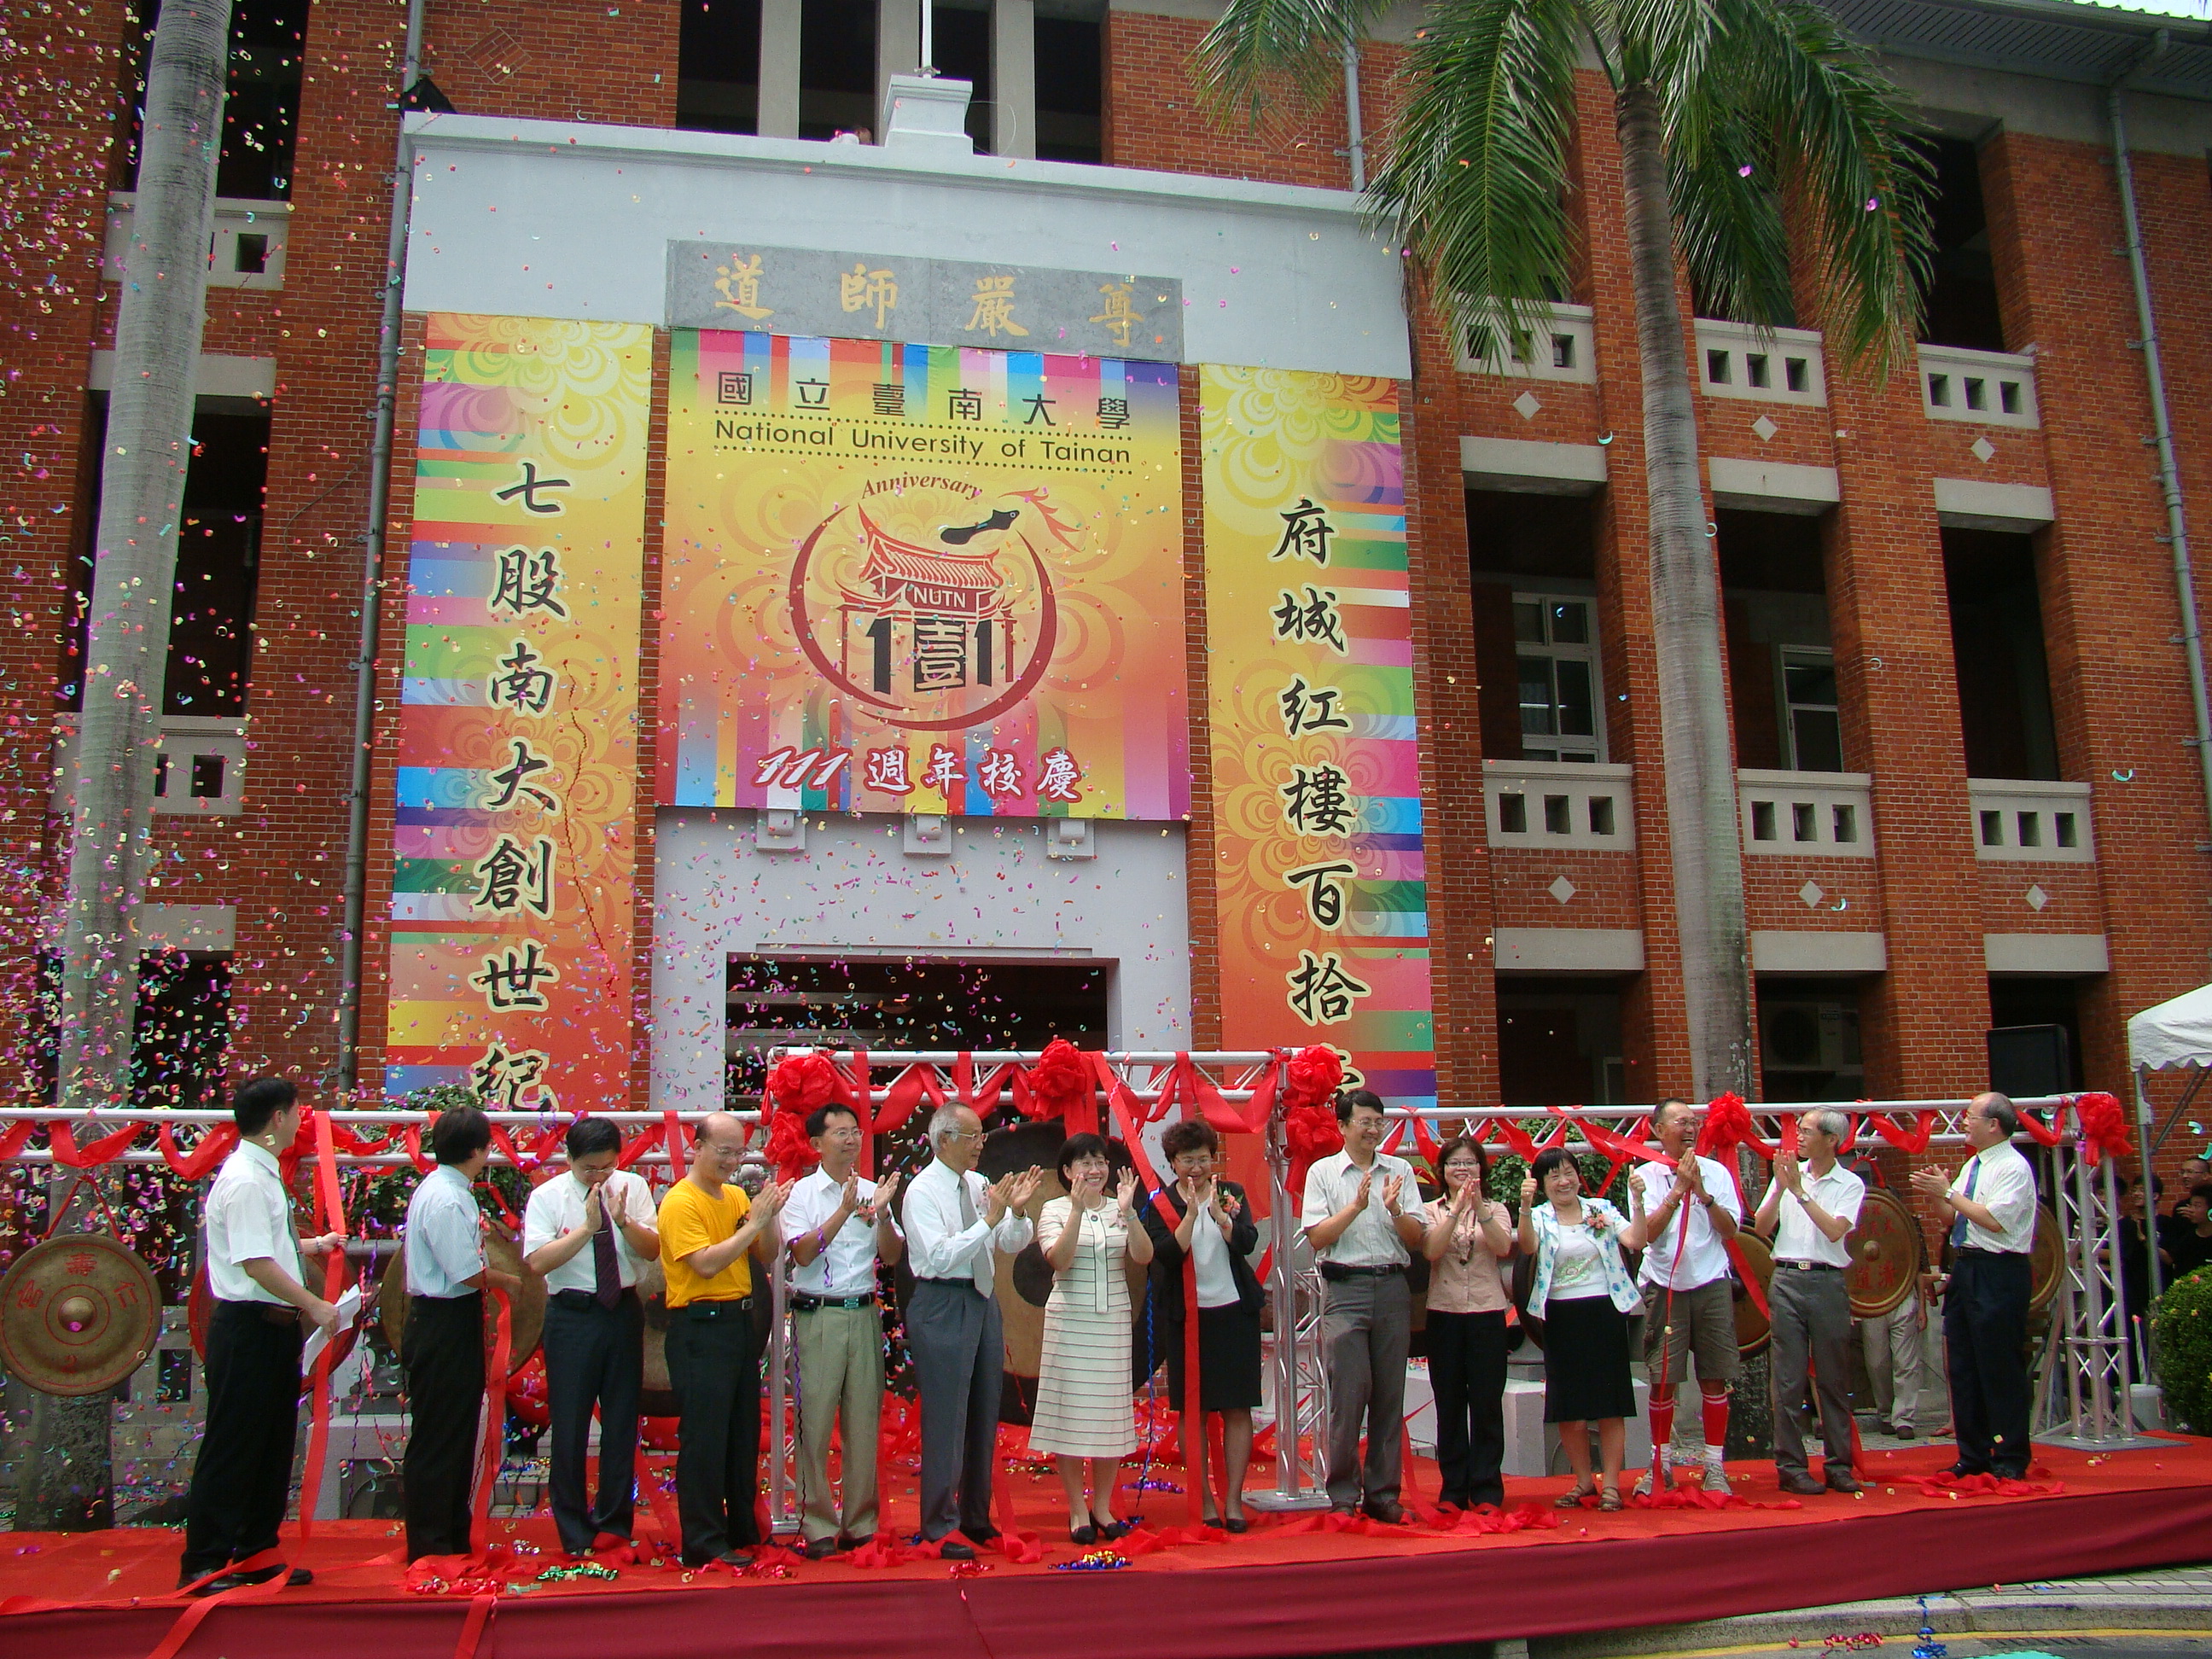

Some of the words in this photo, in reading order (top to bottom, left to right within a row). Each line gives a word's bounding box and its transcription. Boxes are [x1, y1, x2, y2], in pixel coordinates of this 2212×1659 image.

[718, 370, 1131, 430] 國立臺南大學
[715, 418, 834, 446] National
[852, 428, 984, 459] University
[1001, 439, 1027, 458] of
[1040, 439, 1131, 464] Tainan
[861, 470, 984, 502] Anniversary
[913, 586, 966, 608] NUTN
